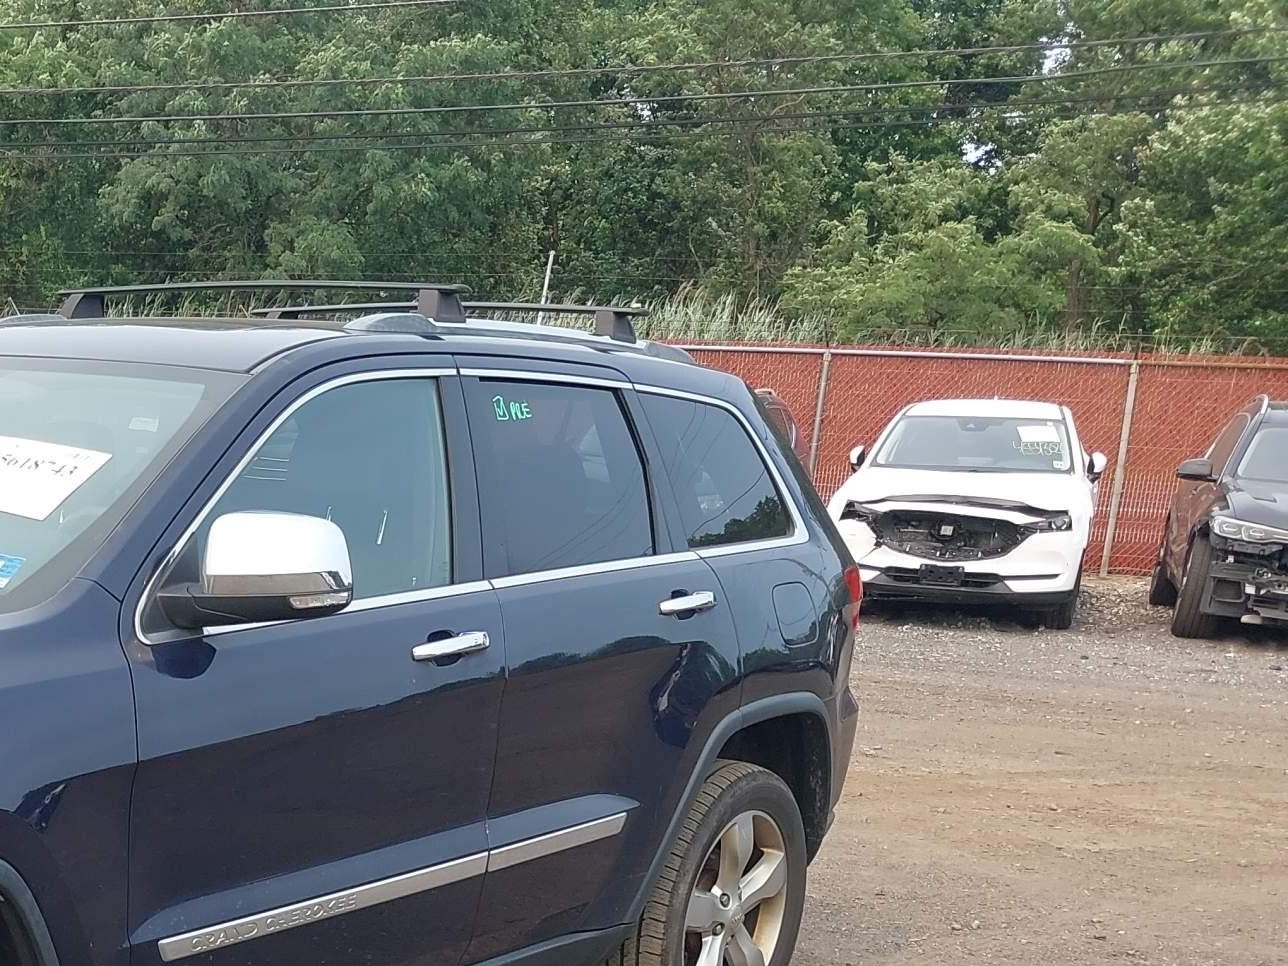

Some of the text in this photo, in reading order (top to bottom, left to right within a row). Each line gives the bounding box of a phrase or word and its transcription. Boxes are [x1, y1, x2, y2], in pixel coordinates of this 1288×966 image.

[509, 401, 533, 420] PRE
[192, 894, 358, 952] GRAND CHEROKEE
